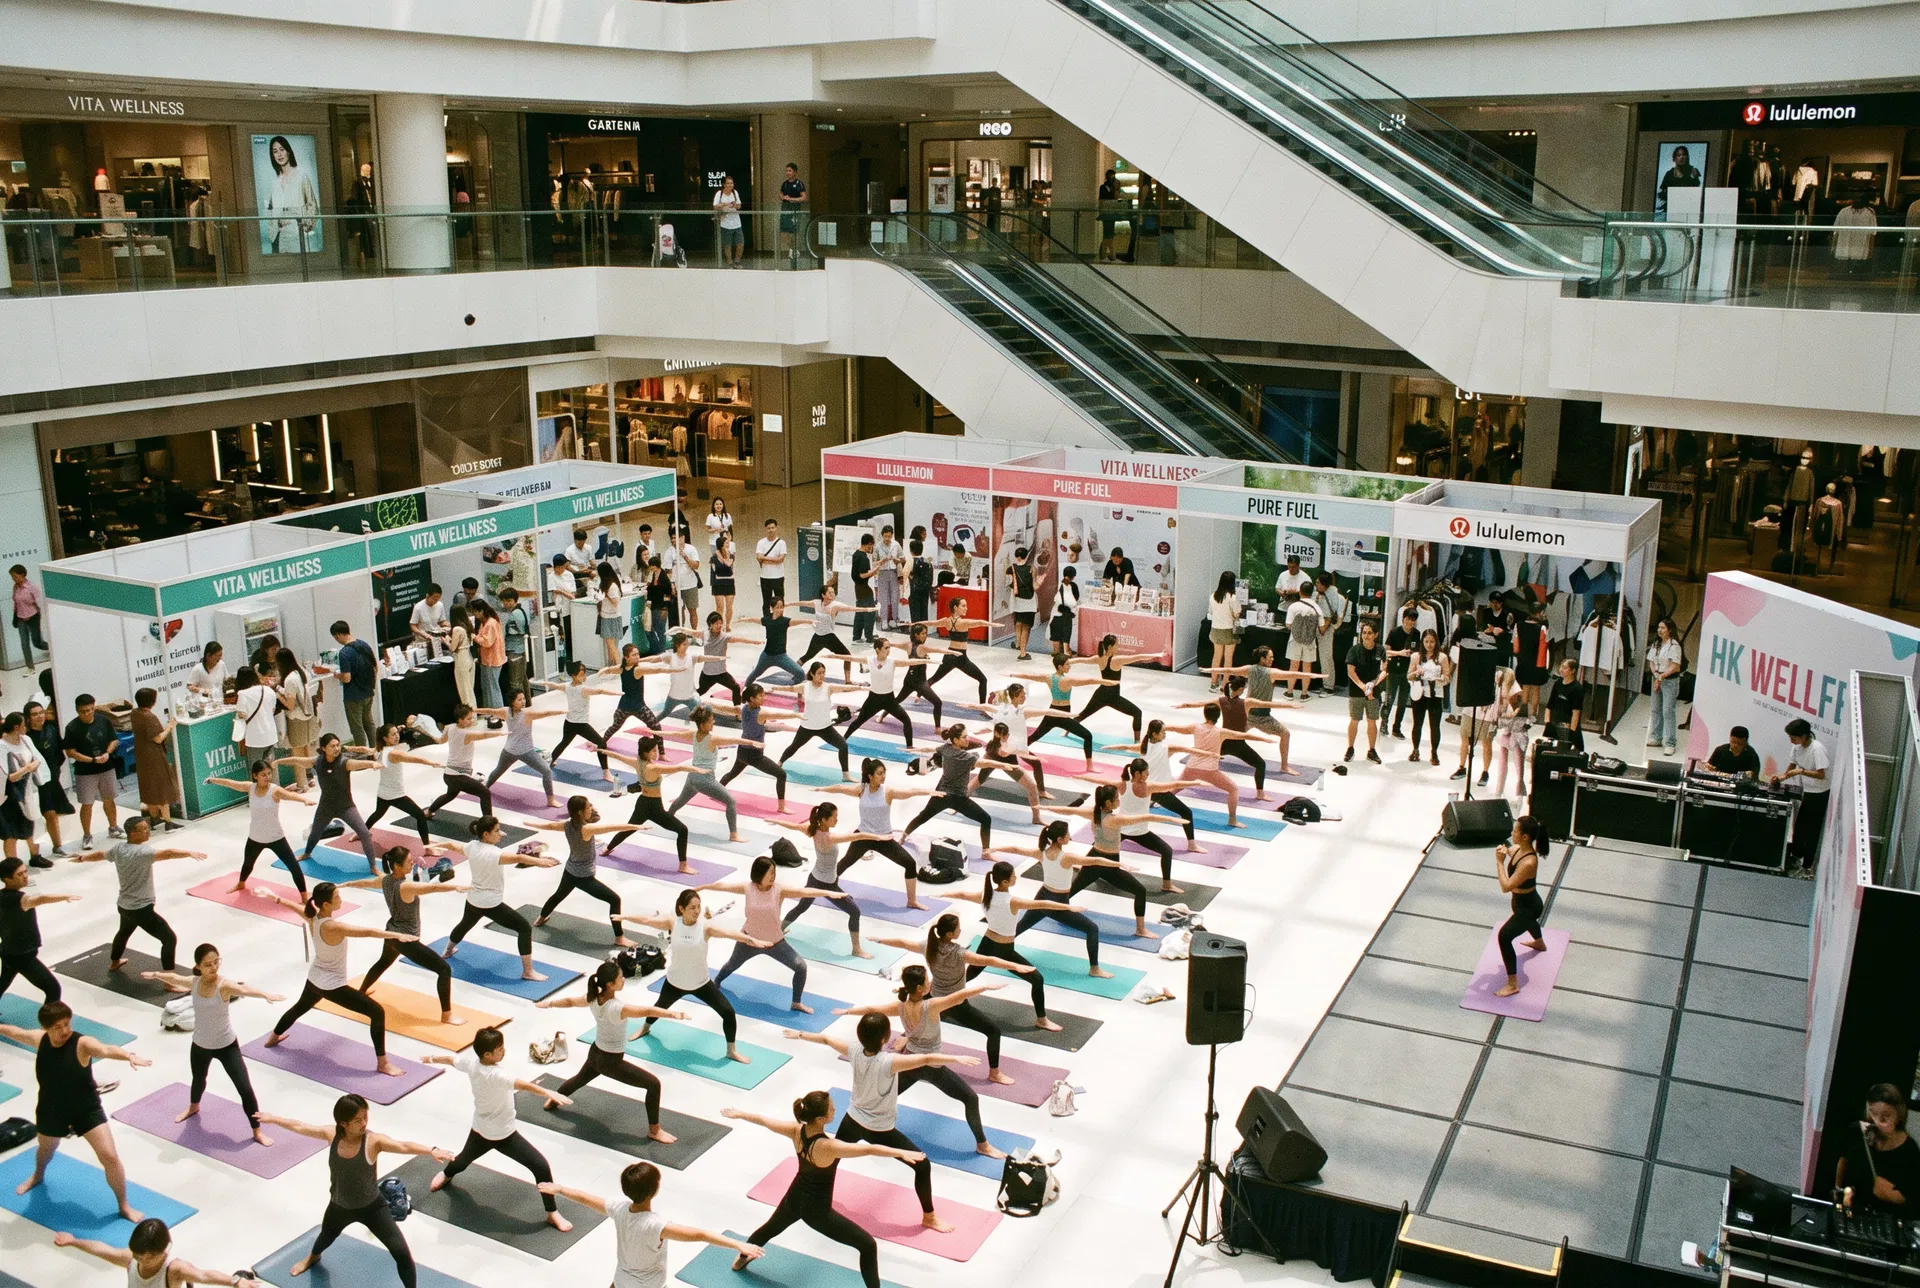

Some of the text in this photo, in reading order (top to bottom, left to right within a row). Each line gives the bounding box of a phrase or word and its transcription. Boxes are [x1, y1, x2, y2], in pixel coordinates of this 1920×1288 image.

[68, 96, 185, 115] VITA WELLNESS
[1769, 104, 1856, 121] lululemon
[876, 463, 933, 480] LULULEMON
[1100, 459, 1199, 481] VITA WELLNESS
[572, 484, 644, 514] VITA WELLNESS
[1053, 479, 1112, 498] PURE FUEL
[1247, 497, 1319, 520] PURE FUEL
[410, 517, 497, 550] VITA WELLNESS
[1476, 521, 1565, 546] lululemon
[212, 557, 322, 598] VITA WELLNESS
[1710, 634, 1745, 685] HK
[204, 744, 236, 768] VITA
